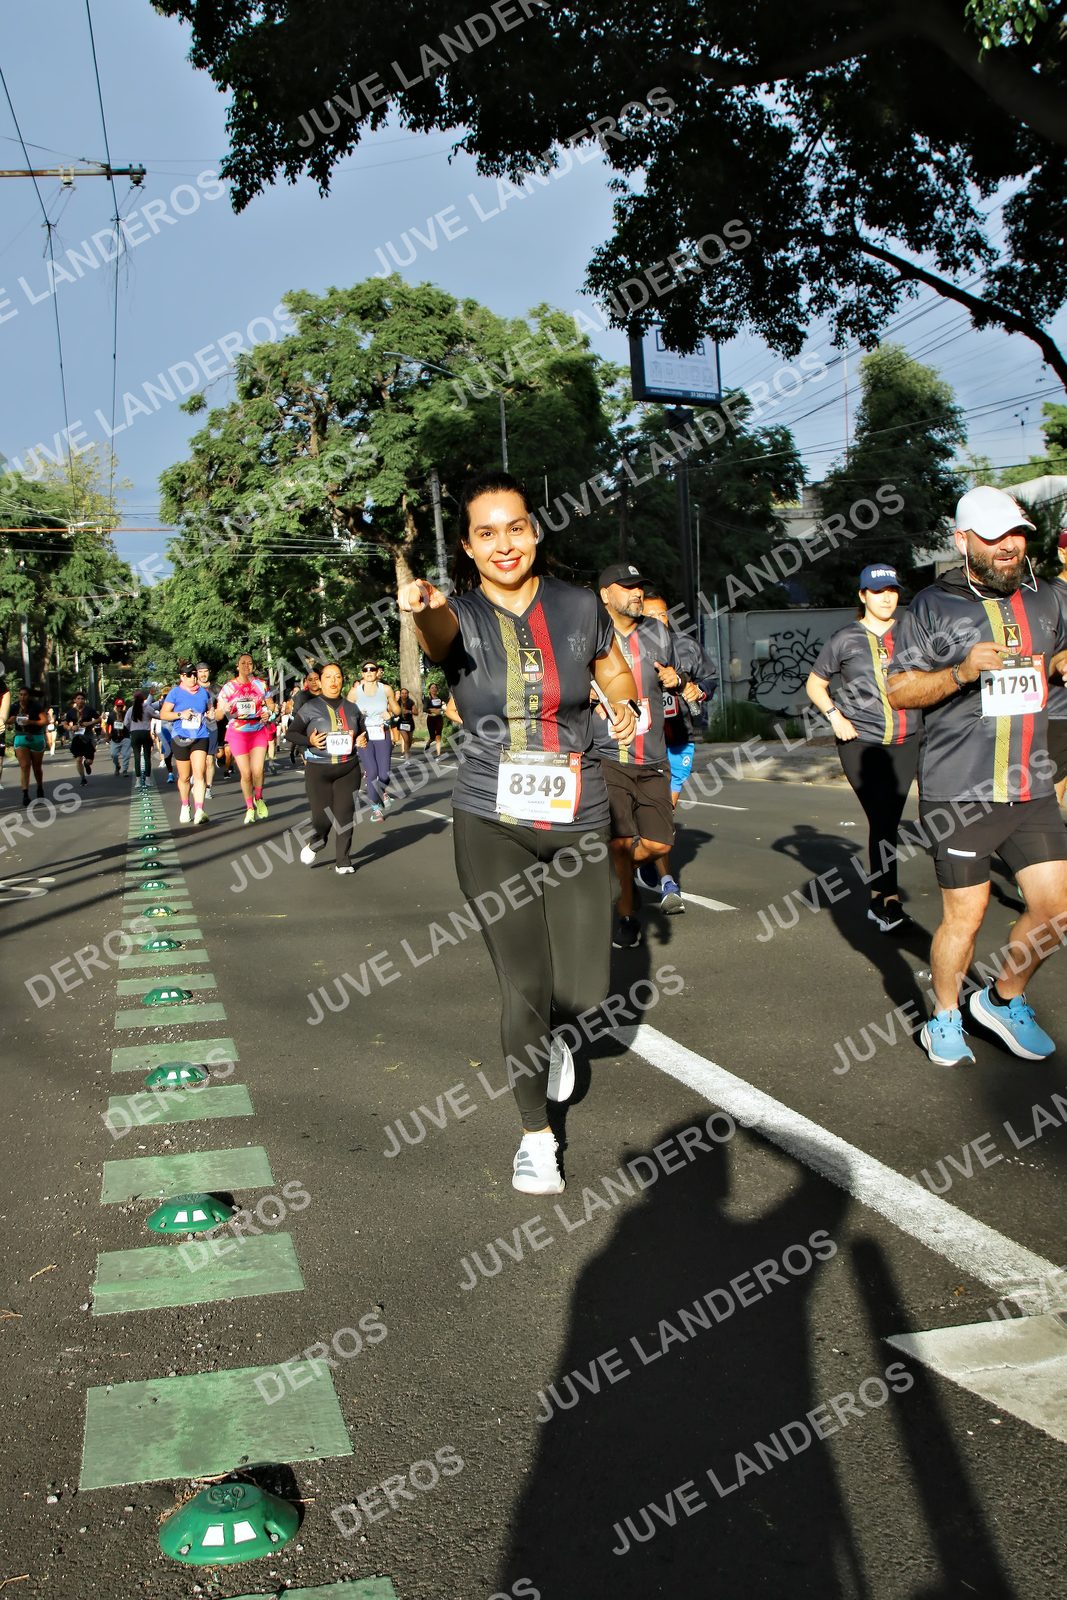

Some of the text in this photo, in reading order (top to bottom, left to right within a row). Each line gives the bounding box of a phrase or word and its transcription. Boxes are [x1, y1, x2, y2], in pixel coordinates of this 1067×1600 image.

[769, 628, 810, 643] TOY
[985, 674, 1037, 695] 11791
[509, 773, 566, 797] 8349
